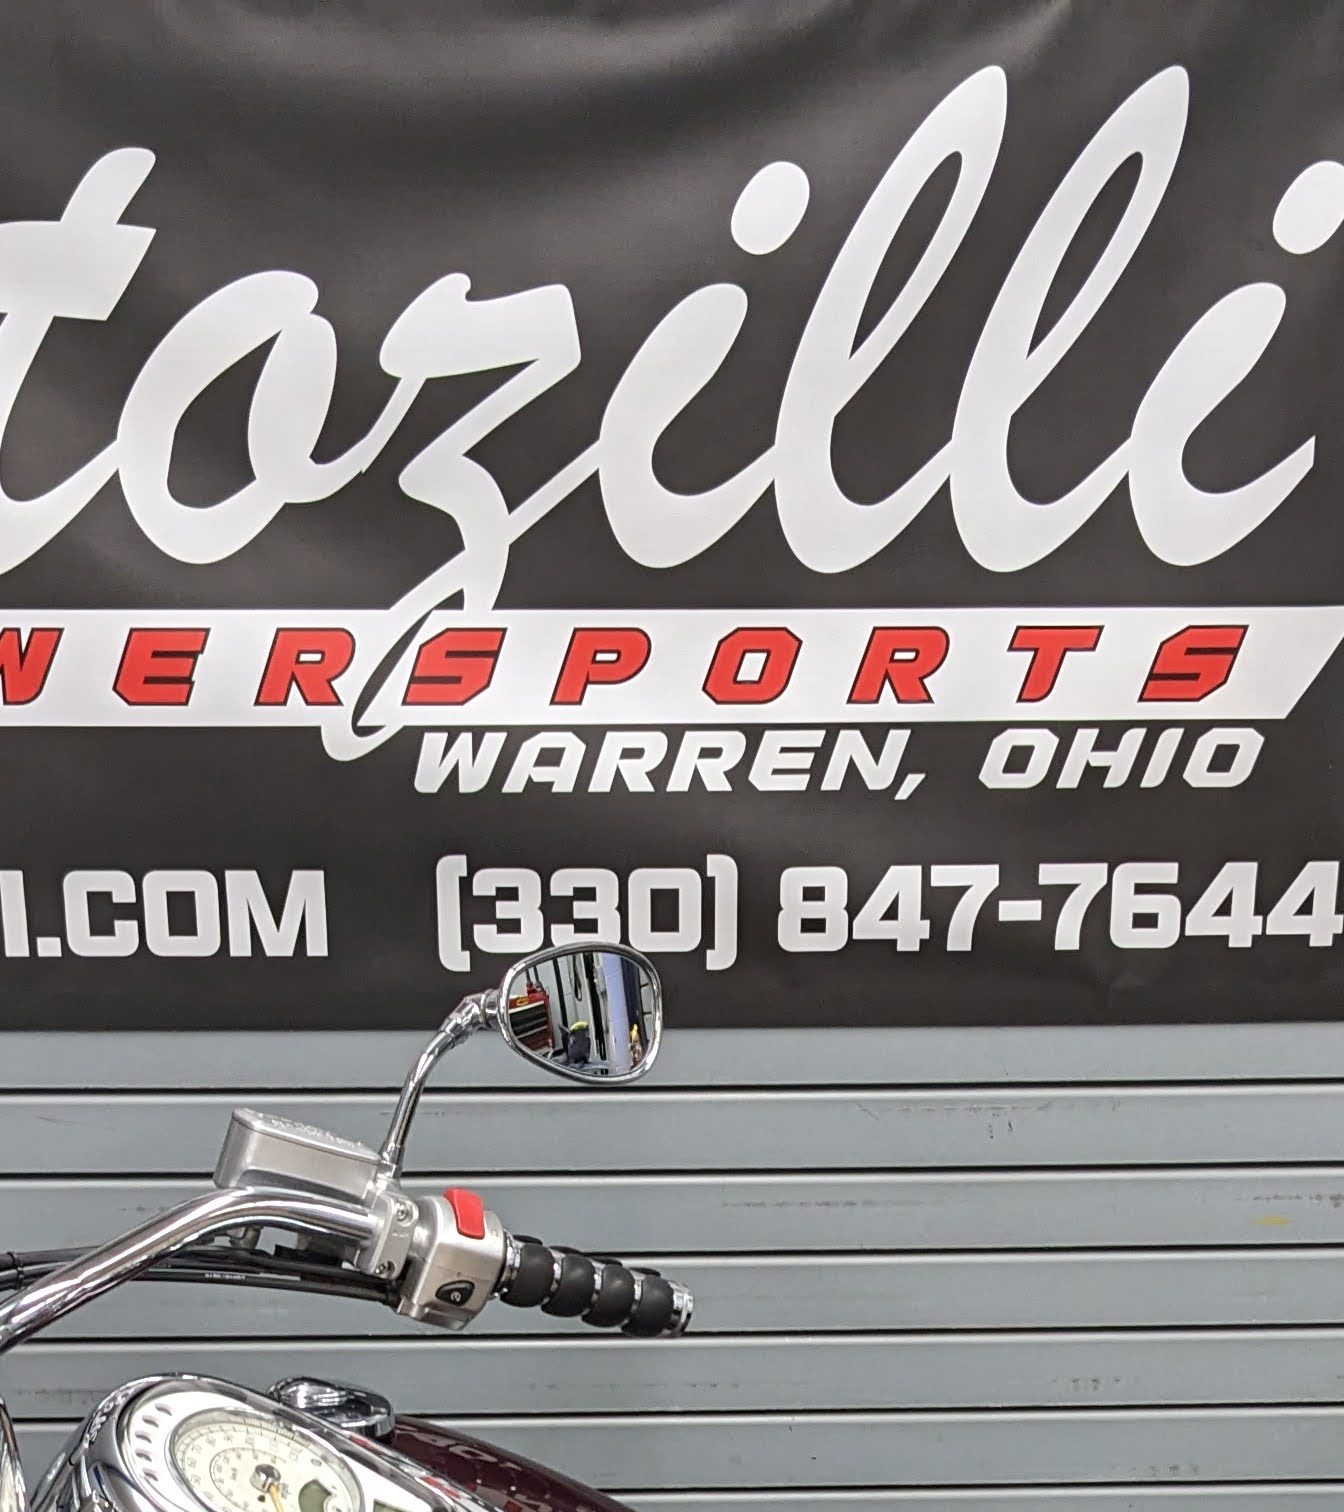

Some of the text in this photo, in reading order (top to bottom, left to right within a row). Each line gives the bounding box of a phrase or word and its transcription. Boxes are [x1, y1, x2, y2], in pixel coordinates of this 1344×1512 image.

[413, 727, 1265, 800] WARREN, OHIO
[435, 853, 739, 971] (330)
[777, 860, 1344, 952] 847-7644
